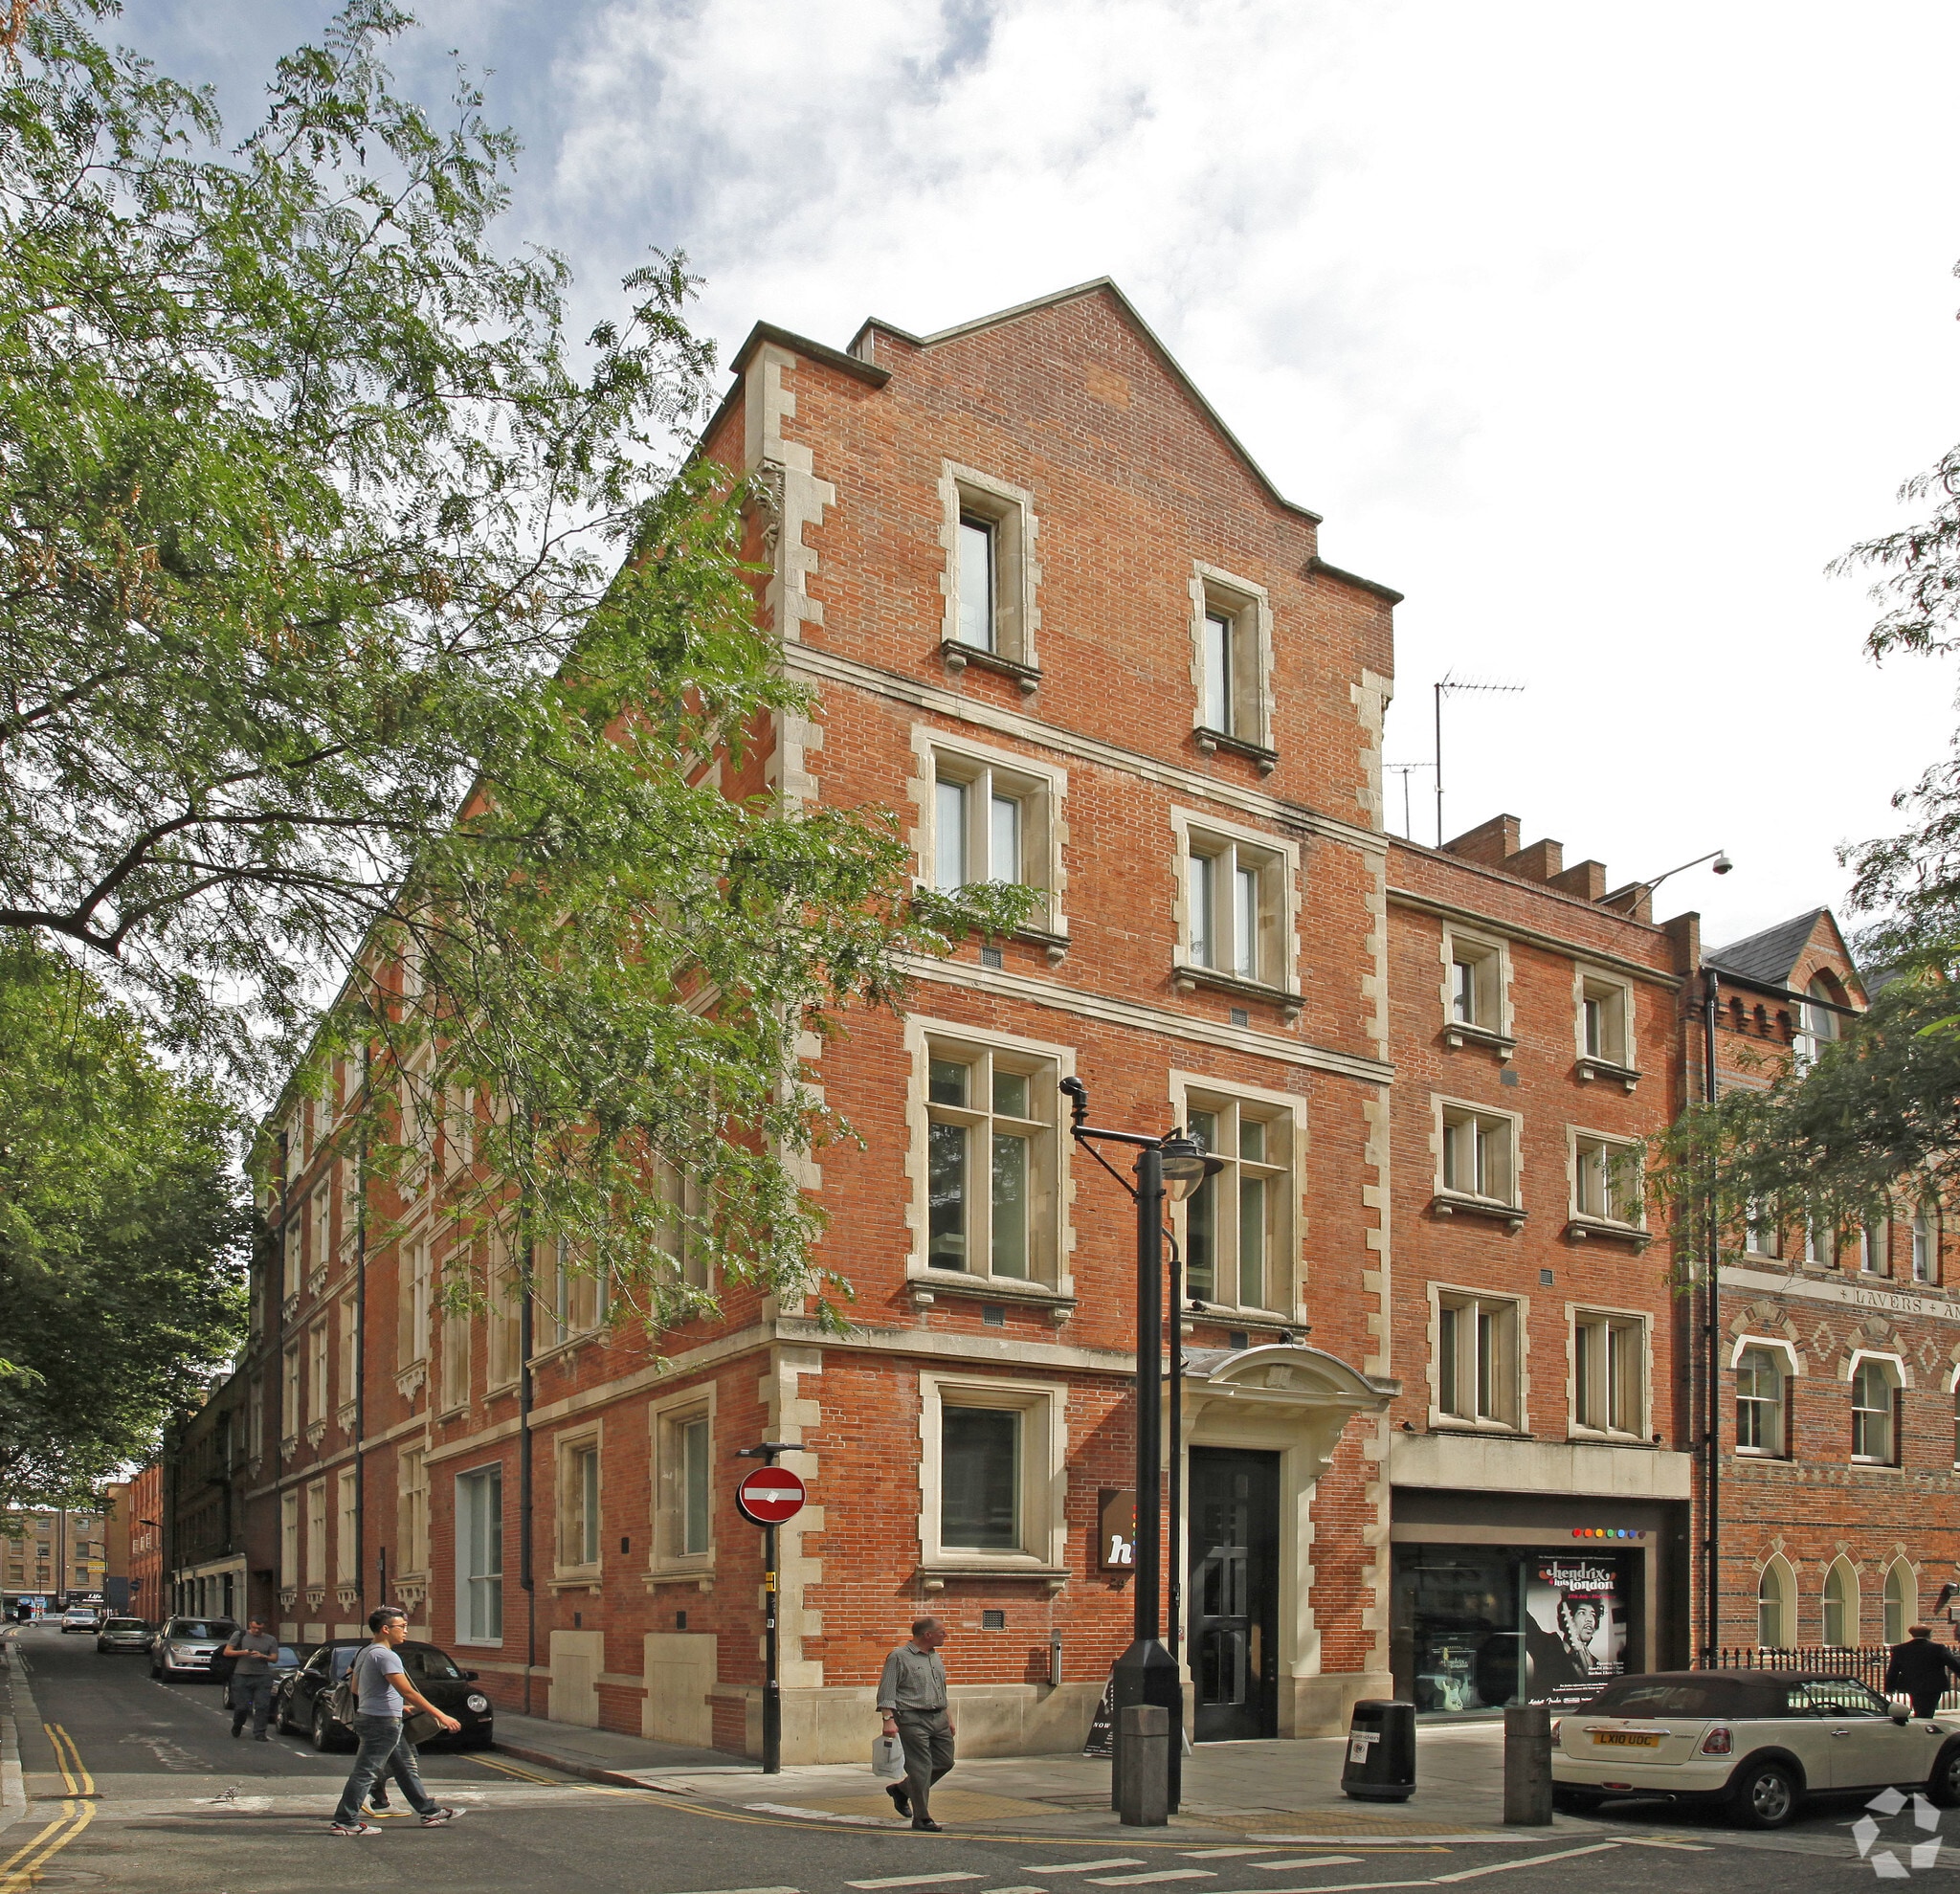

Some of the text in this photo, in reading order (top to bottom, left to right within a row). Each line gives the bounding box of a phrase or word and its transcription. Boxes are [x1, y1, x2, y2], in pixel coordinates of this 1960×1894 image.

[1856, 1290, 1922, 1312] LAVERS
[1108, 1535, 1132, 1564] h
[1546, 1561, 1611, 1581] hendrix
[1570, 1578, 1614, 1592] london
[1600, 1734, 1626, 1744] LX10
